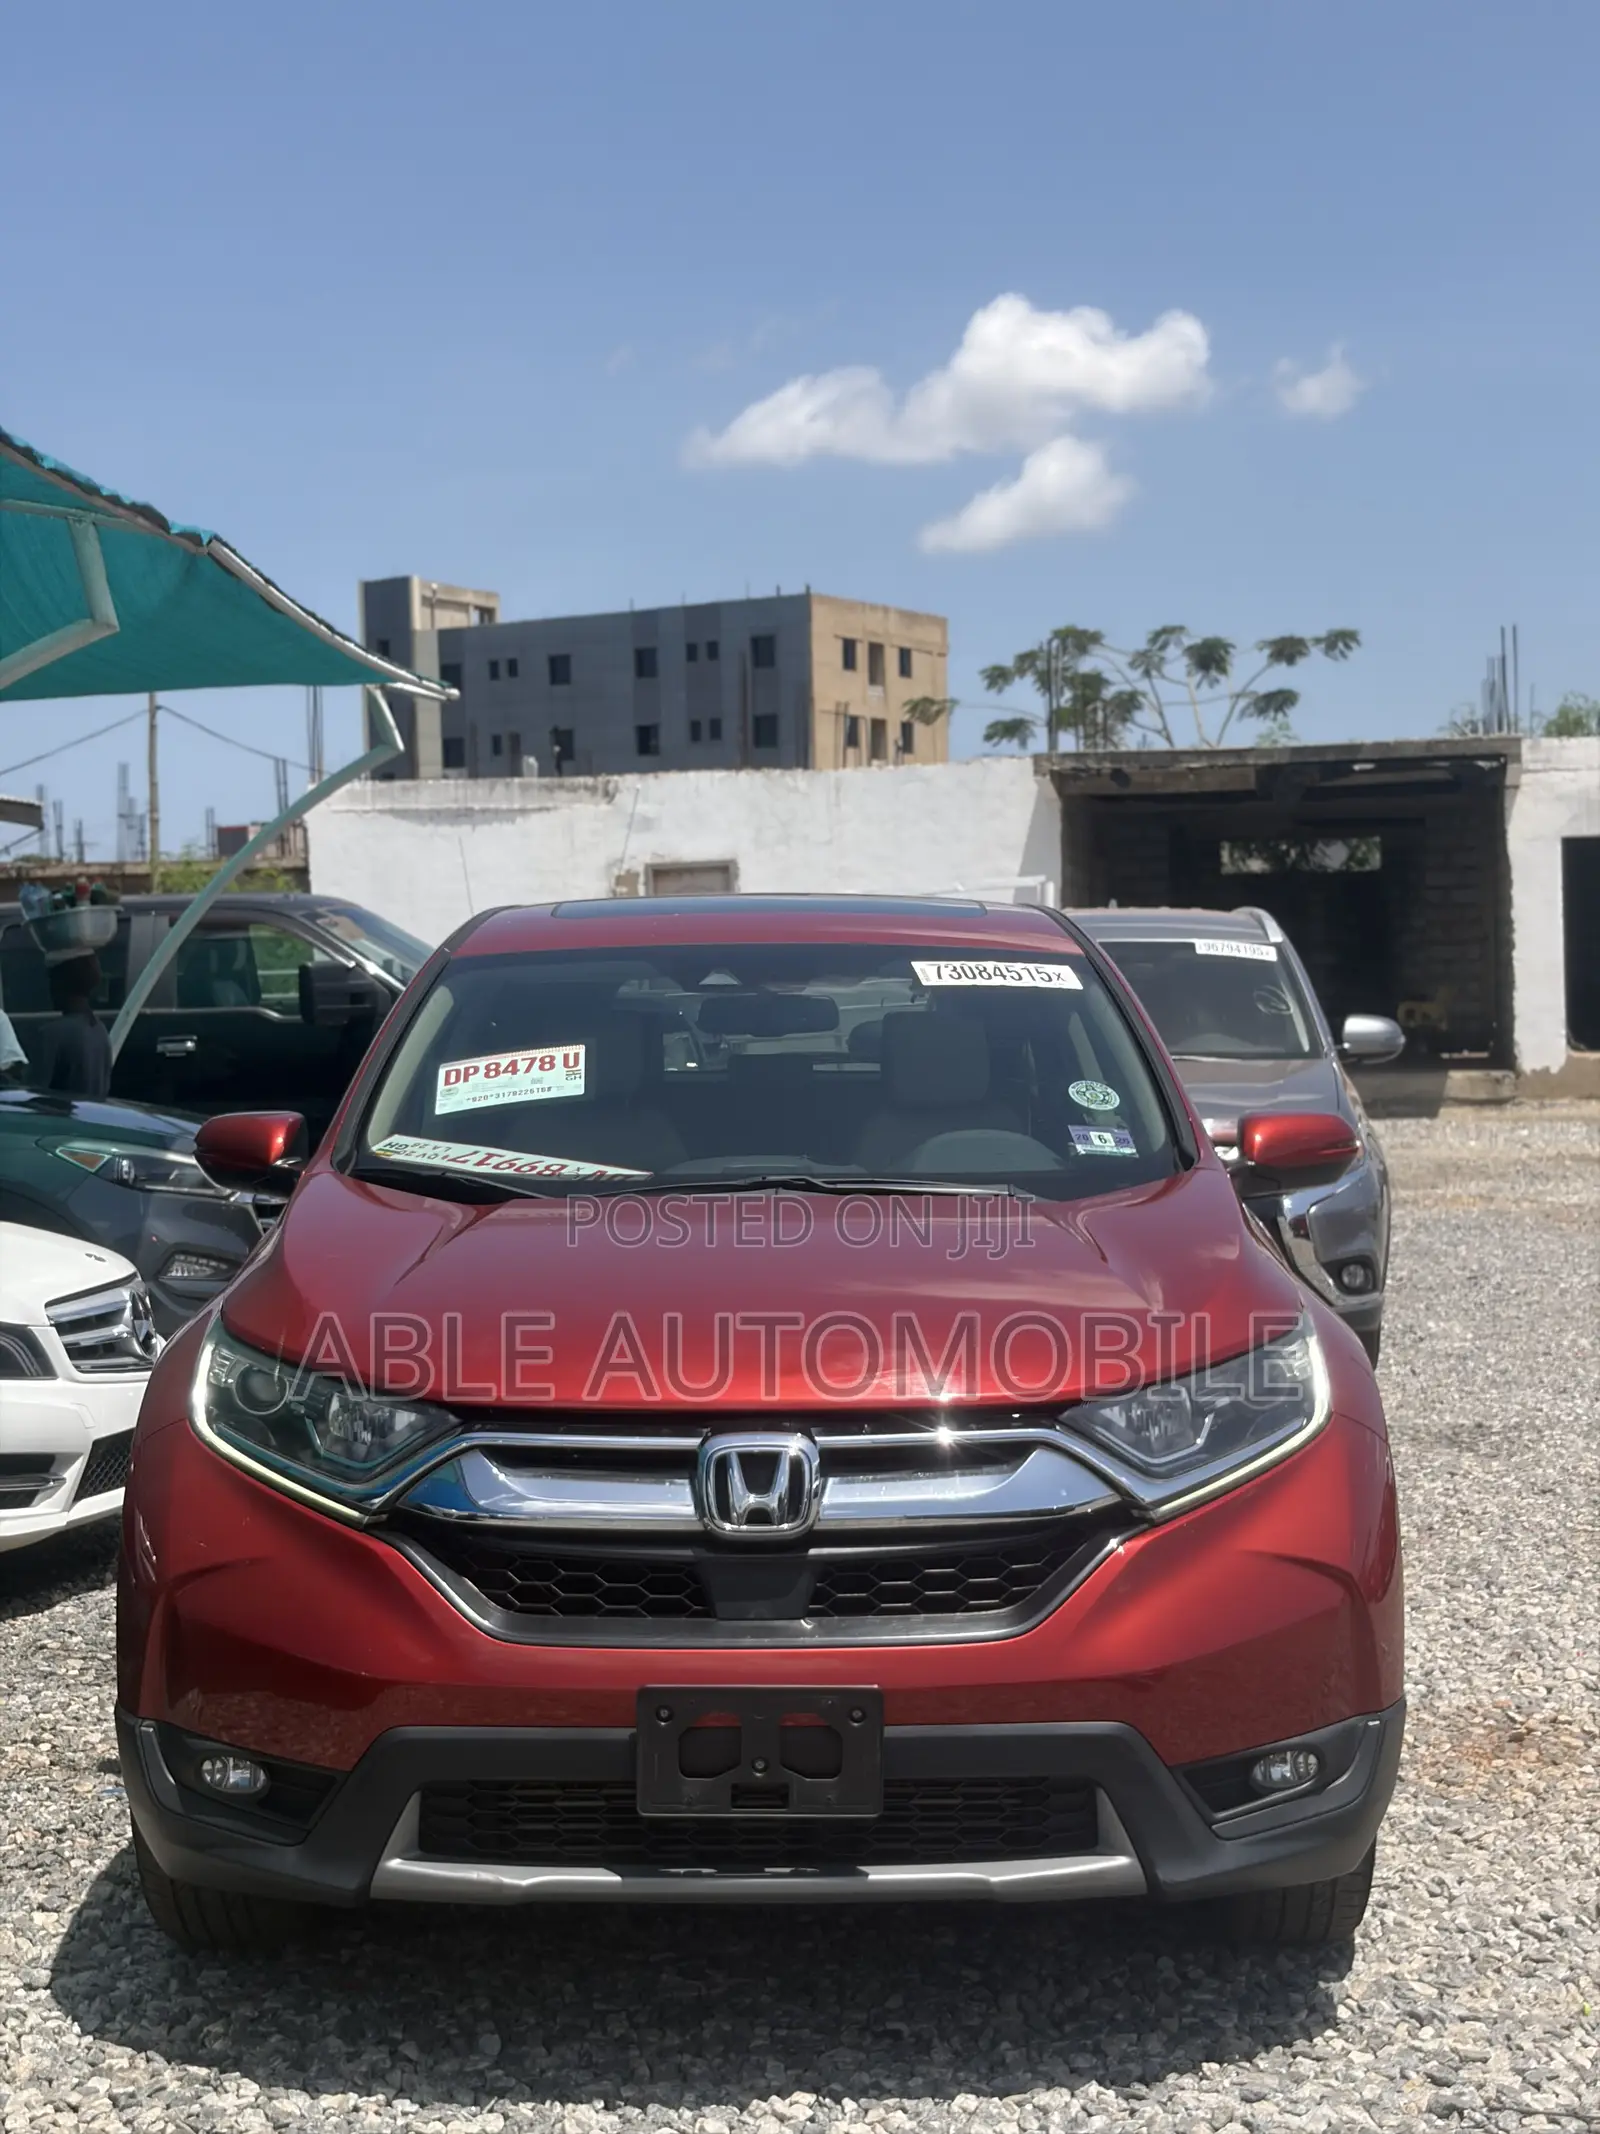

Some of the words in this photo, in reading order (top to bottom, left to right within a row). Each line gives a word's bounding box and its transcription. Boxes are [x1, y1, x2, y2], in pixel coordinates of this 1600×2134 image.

[444, 1065, 480, 1087] DP
[483, 1055, 556, 1079] 8478
[563, 1052, 580, 1069] U
[1098, 1134, 1107, 1144] 6
[383, 1141, 409, 1150] GH
